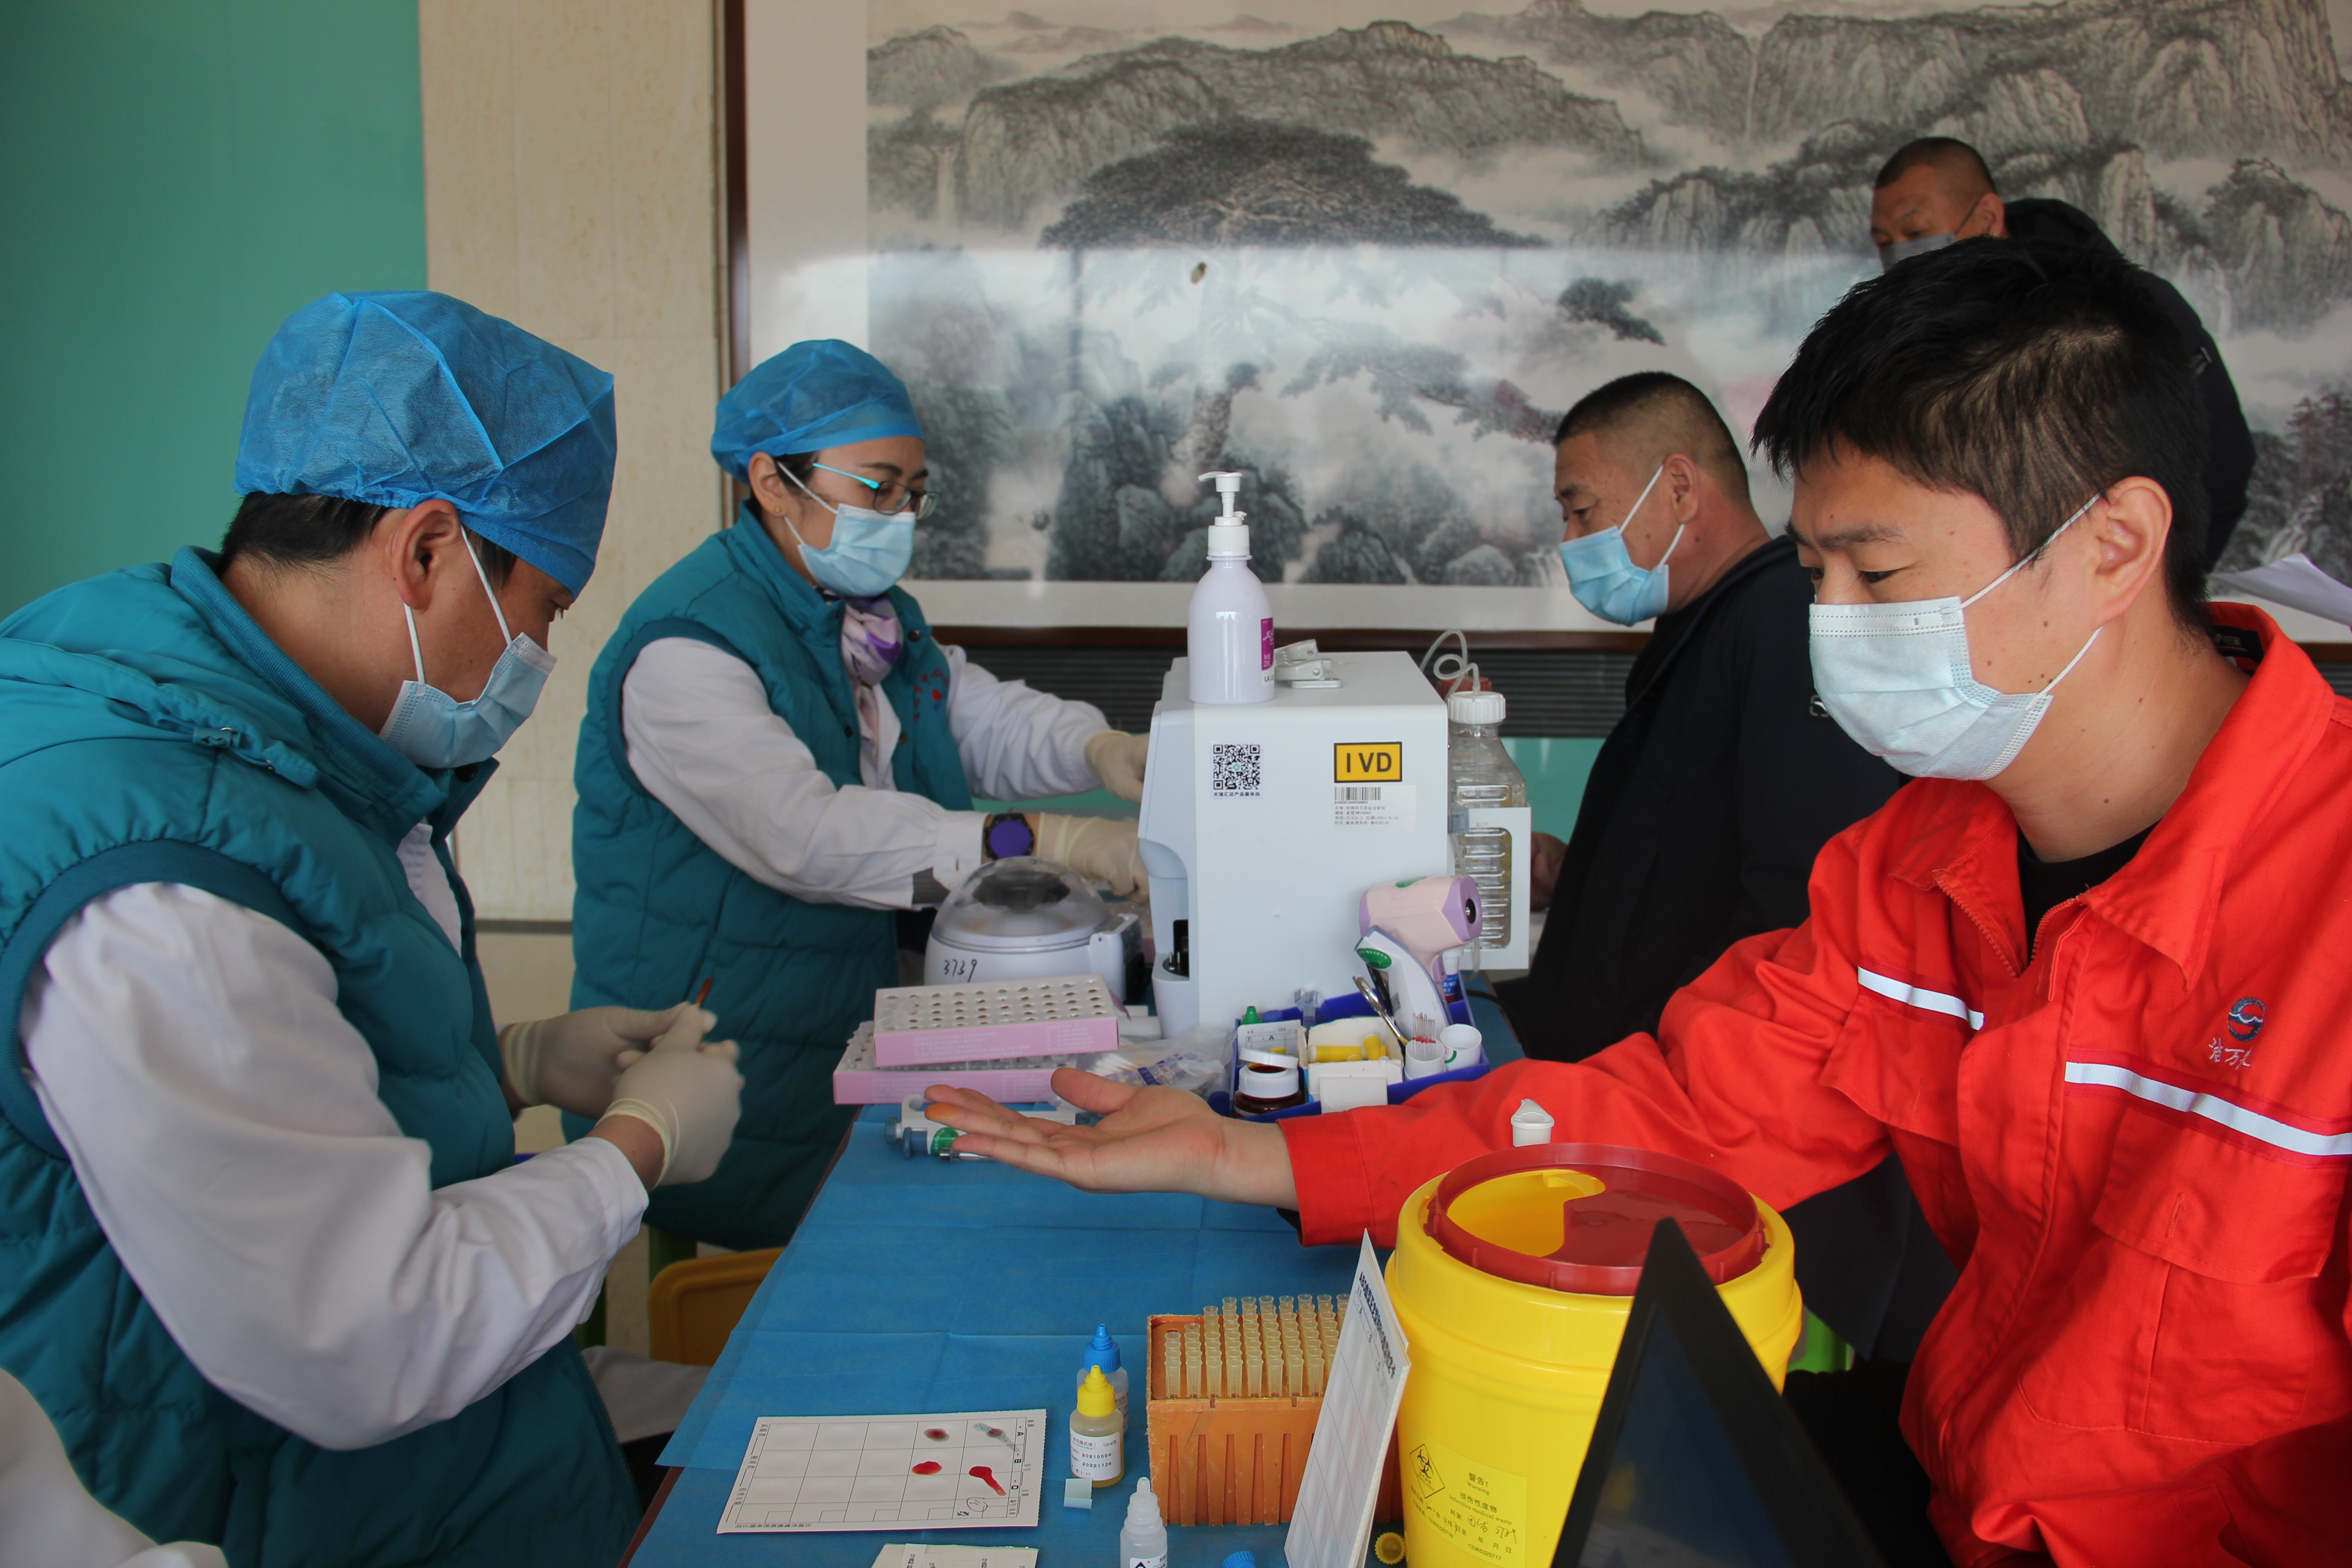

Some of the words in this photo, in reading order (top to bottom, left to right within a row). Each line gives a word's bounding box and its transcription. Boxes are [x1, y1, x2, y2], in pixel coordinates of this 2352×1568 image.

[1347, 752, 1392, 773] IVD
[1469, 1472, 1488, 1487] 警告!
[1466, 1480, 1490, 1496] Warning
[1460, 1492, 1498, 1514] 损伤性废物
[1472, 1507, 1494, 1519] medical
